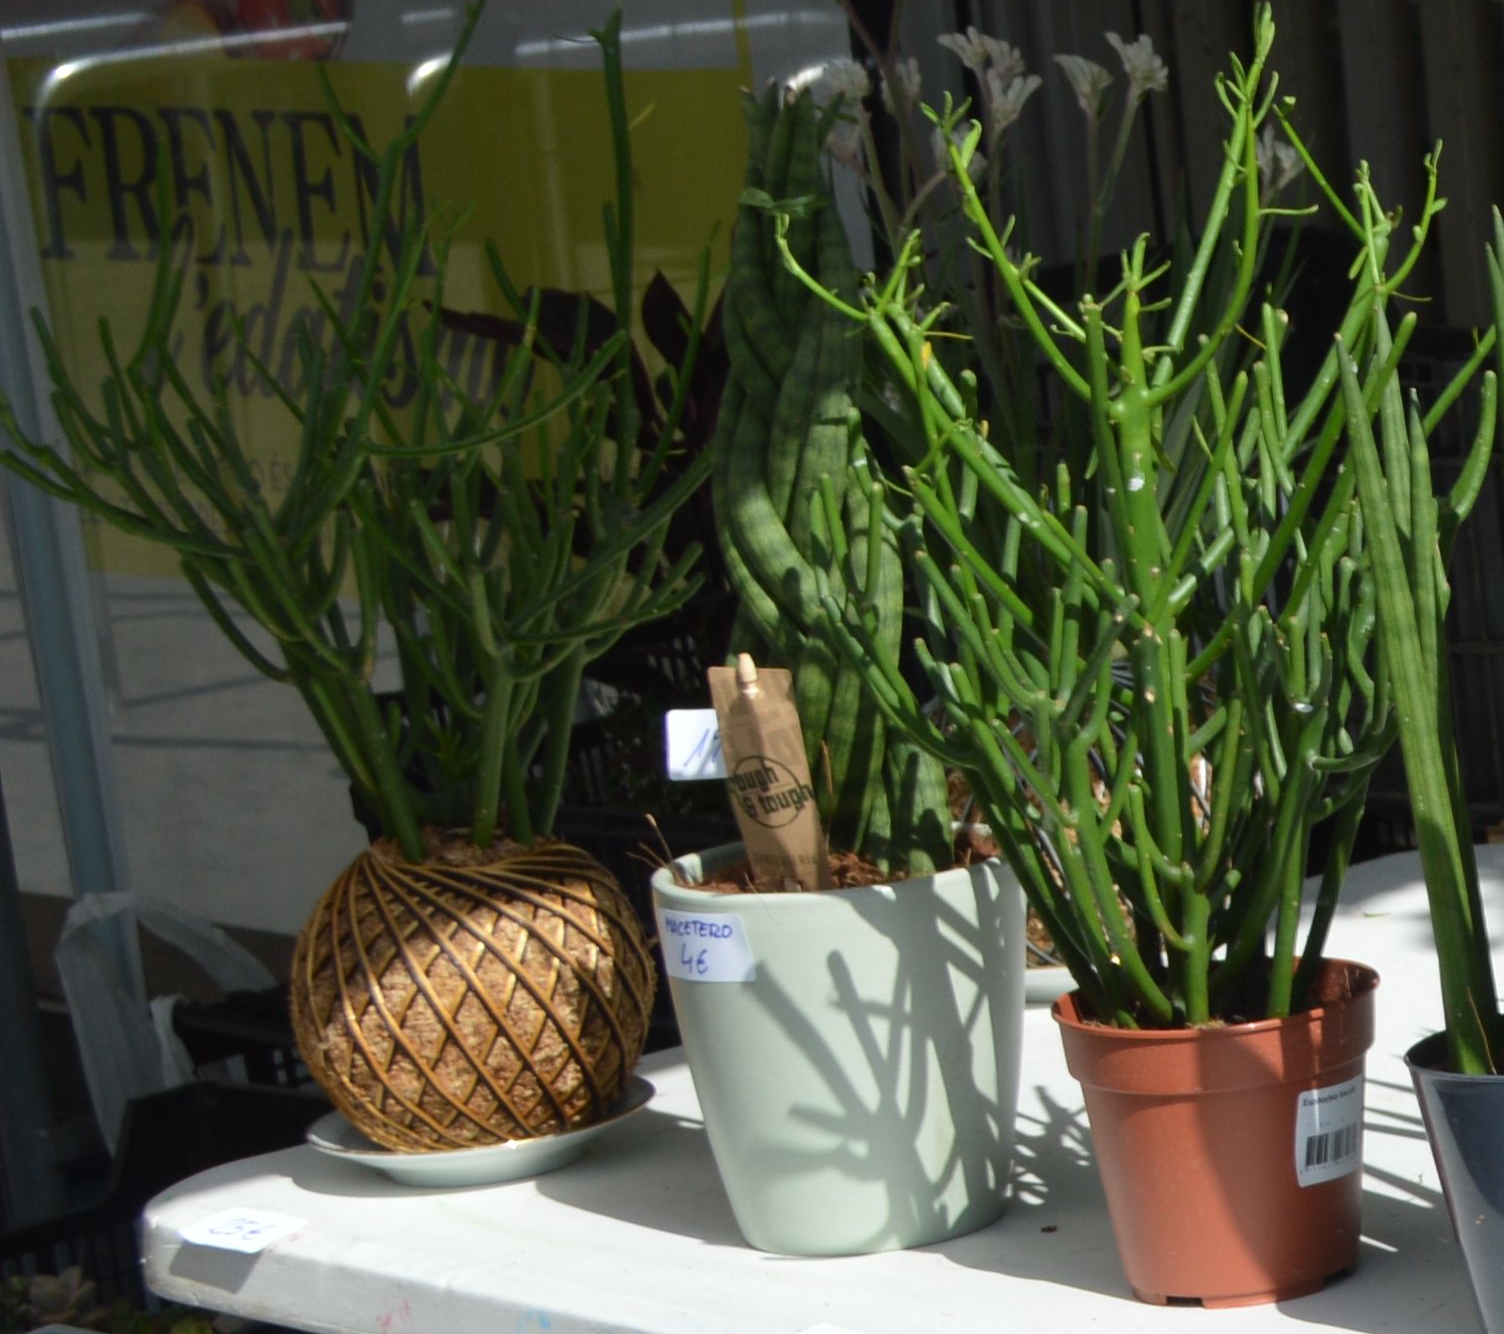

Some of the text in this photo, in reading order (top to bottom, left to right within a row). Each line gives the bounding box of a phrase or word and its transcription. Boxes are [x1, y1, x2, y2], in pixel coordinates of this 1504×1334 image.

[25, 107, 437, 274] FRENEM
[757, 784, 815, 815] tough
[665, 917, 733, 939] MACETERO
[681, 943, 708, 975] 4€
